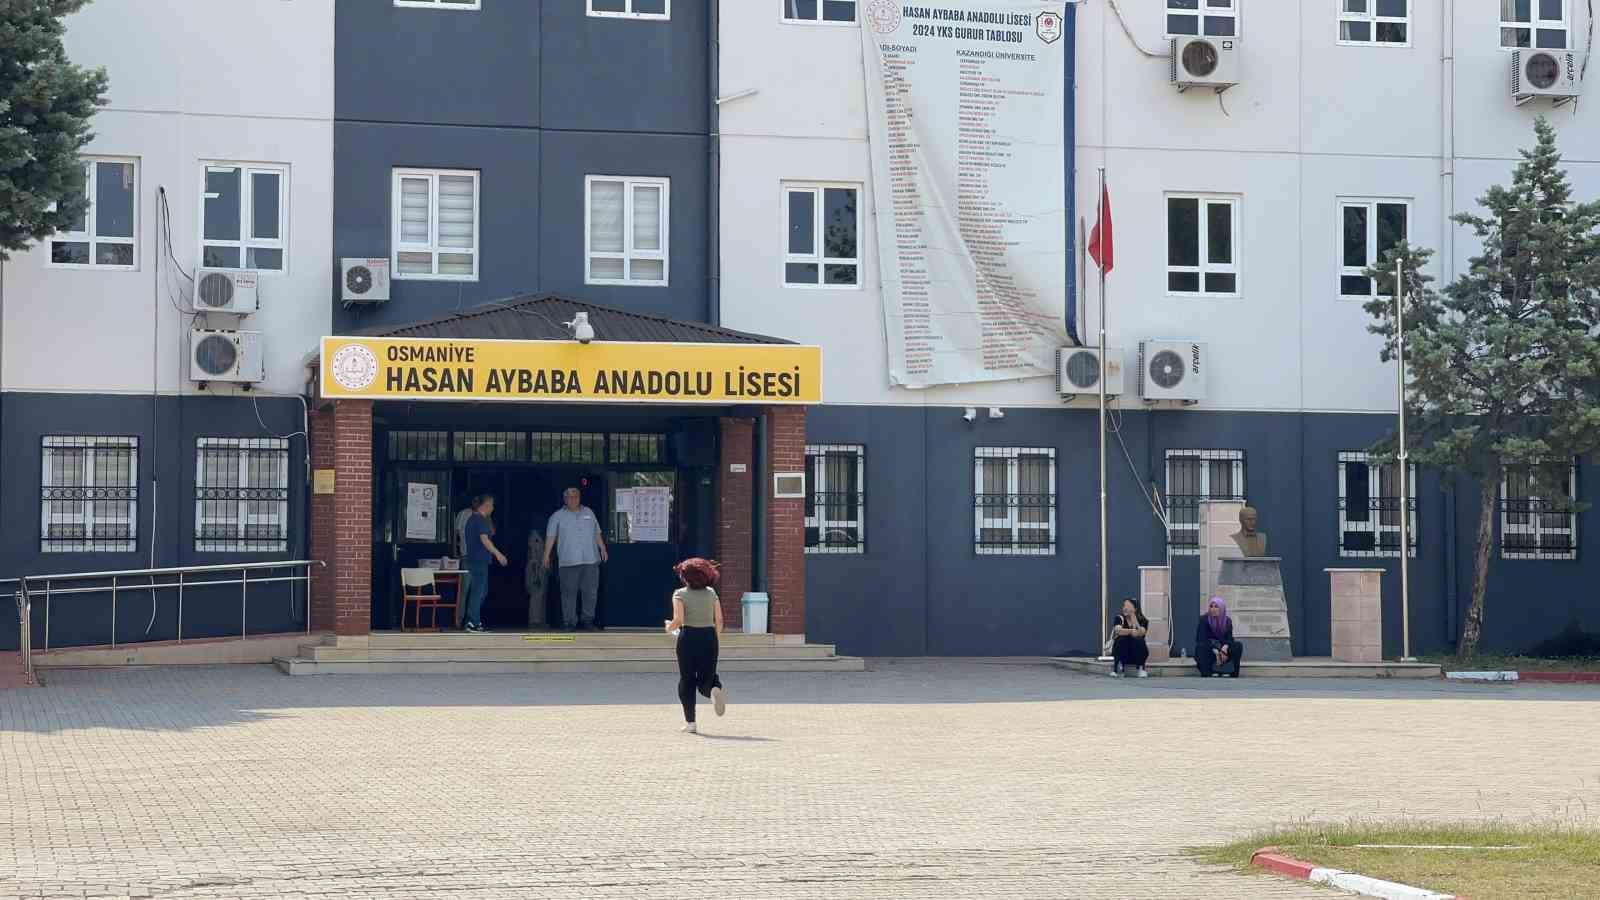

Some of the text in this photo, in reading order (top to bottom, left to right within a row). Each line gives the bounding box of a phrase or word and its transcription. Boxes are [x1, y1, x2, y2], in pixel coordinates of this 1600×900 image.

[903, 6, 931, 19] HASAN
[932, 8, 965, 22] AYBABA
[966, 11, 1005, 25] ANADOLU
[1006, 11, 1032, 27] LİSESİ
[912, 24, 1023, 43] 2024 YKS GURUR TABLOSU
[387, 343, 475, 363] OSMANİYE
[386, 366, 474, 393] HASAN
[485, 368, 582, 394] AYBABA
[593, 369, 712, 396] ANADOLU
[724, 365, 800, 397] LİSESİ
